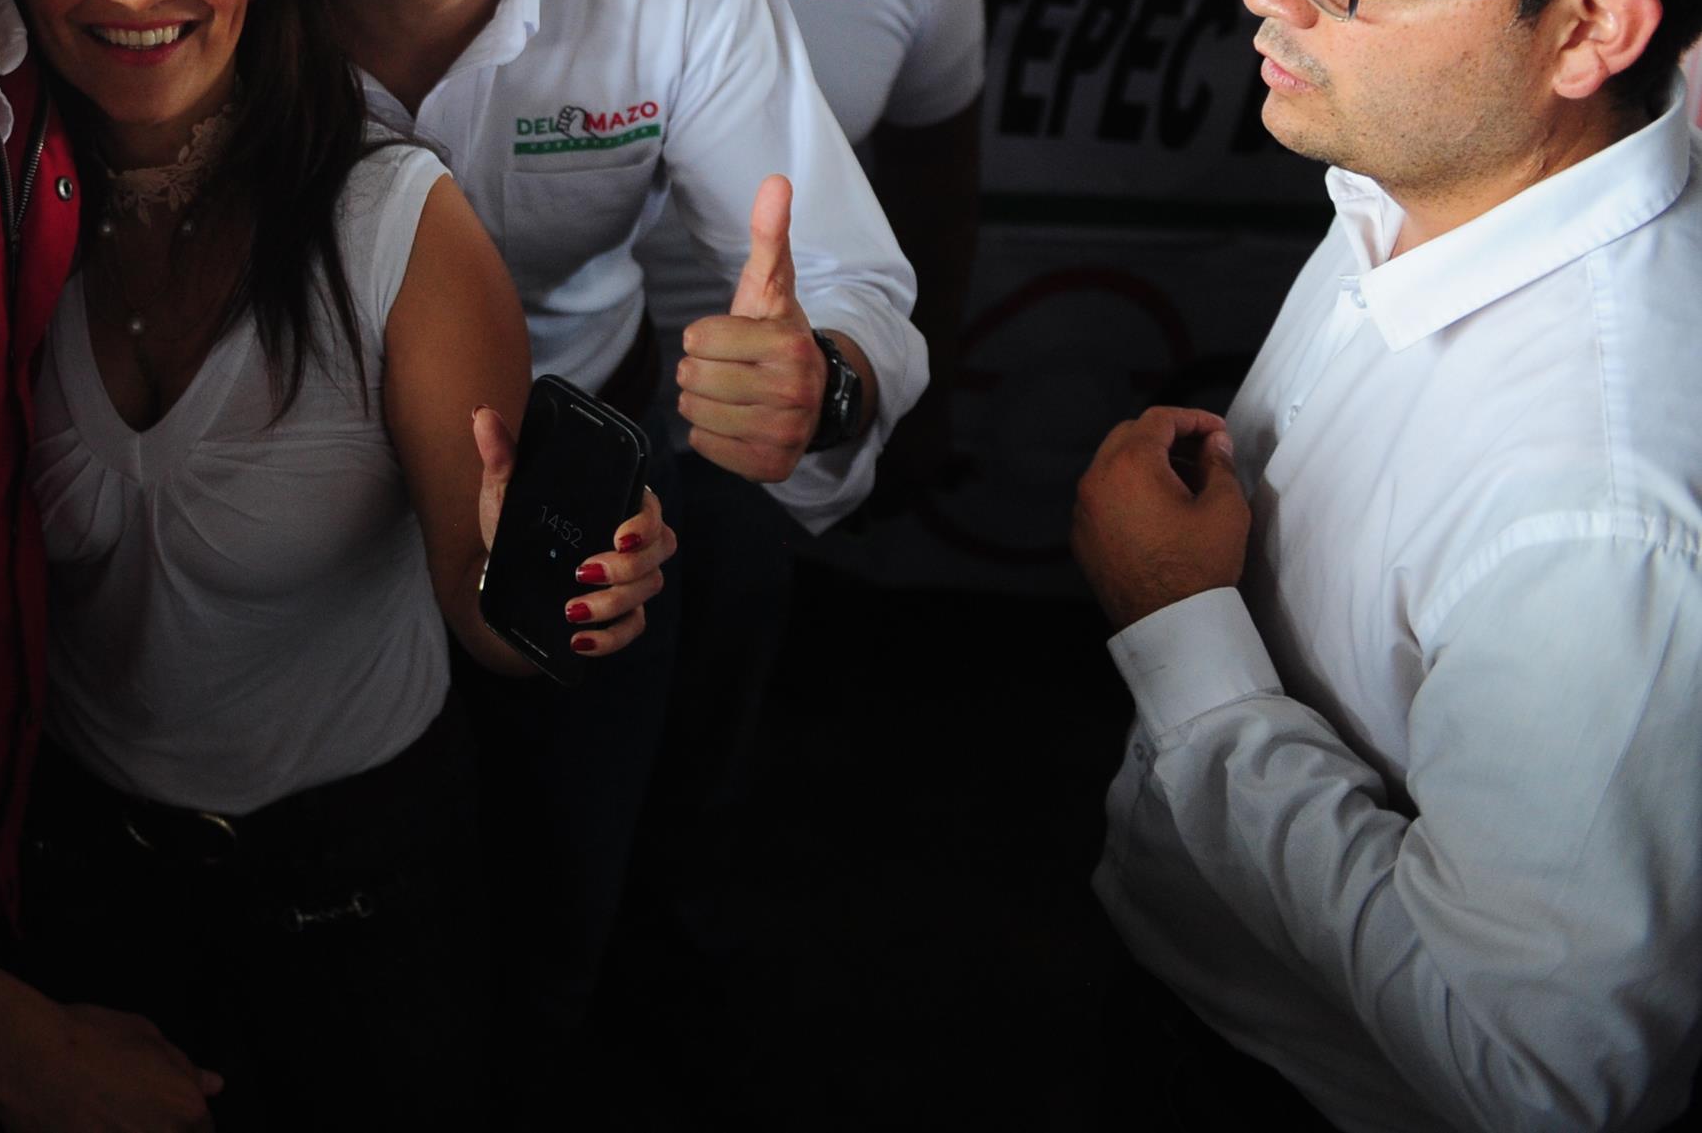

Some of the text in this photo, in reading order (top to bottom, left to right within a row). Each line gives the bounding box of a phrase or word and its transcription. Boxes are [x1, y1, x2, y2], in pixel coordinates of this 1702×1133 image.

[516, 101, 659, 136] DEL MAZO
[541, 505, 583, 549] 14:52
